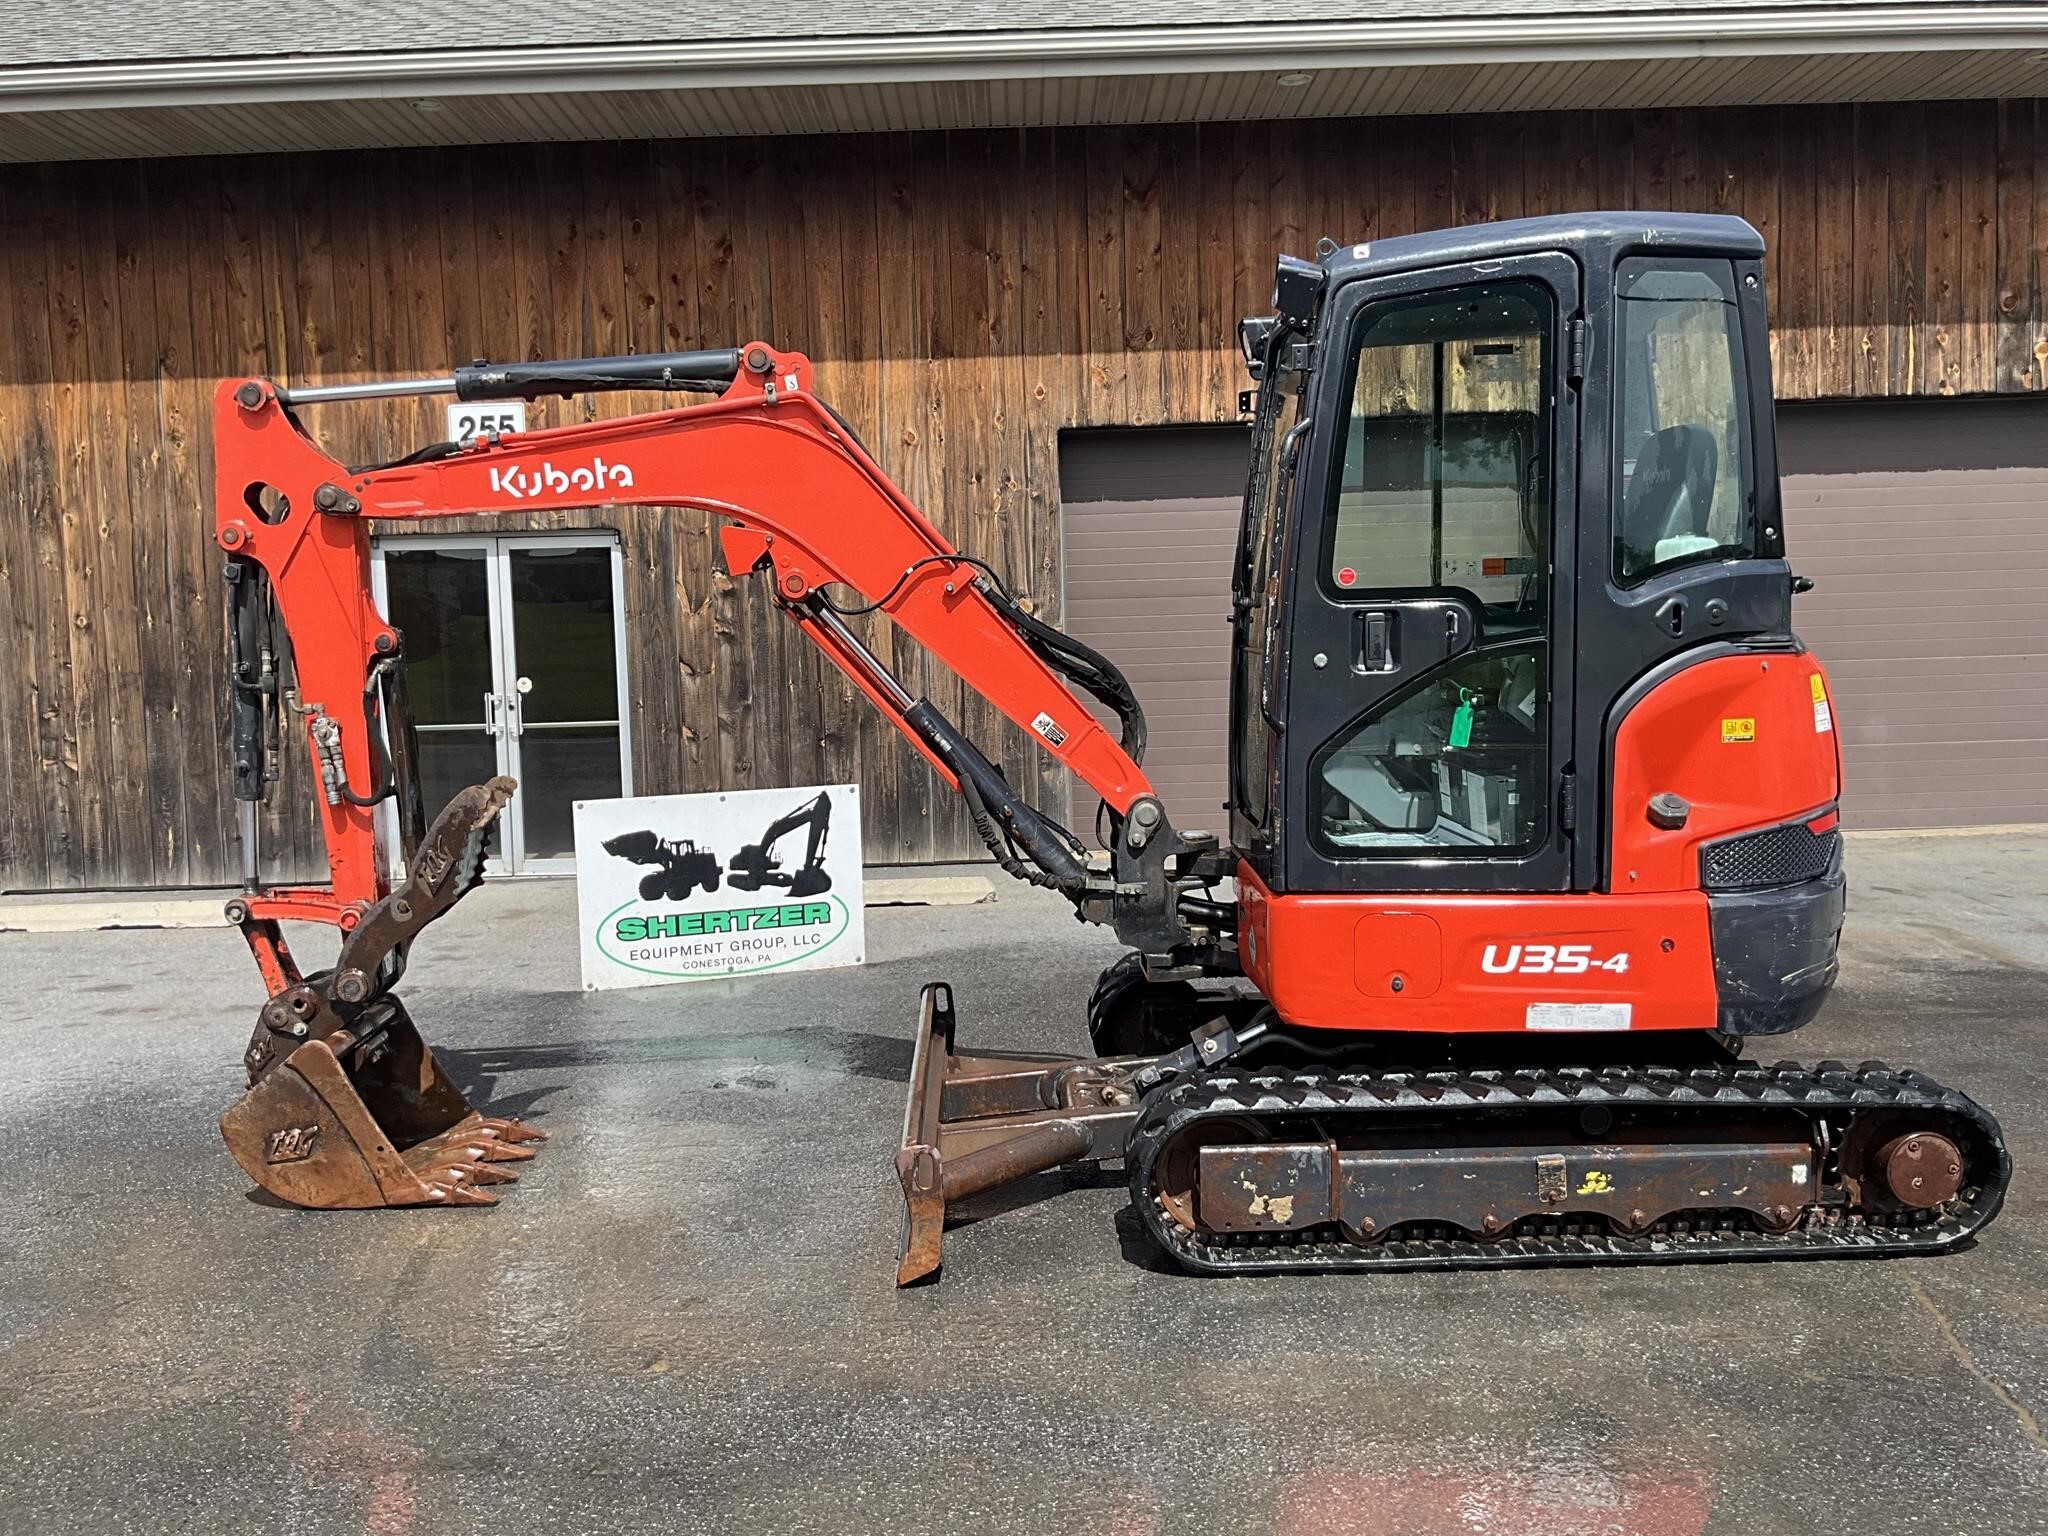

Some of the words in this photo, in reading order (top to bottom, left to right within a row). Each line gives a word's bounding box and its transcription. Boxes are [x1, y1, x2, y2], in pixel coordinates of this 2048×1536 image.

[458, 414, 516, 442] 255
[489, 457, 634, 498] Kubota
[616, 902, 831, 942] SHERTZER
[630, 942, 723, 962] EQUIPMENT
[729, 937, 788, 952] GROUP,
[793, 933, 821, 947] LLC
[1481, 945, 1629, 974] U35-4
[682, 957, 754, 971] CONESTOGA,
[758, 954, 772, 963] PA
